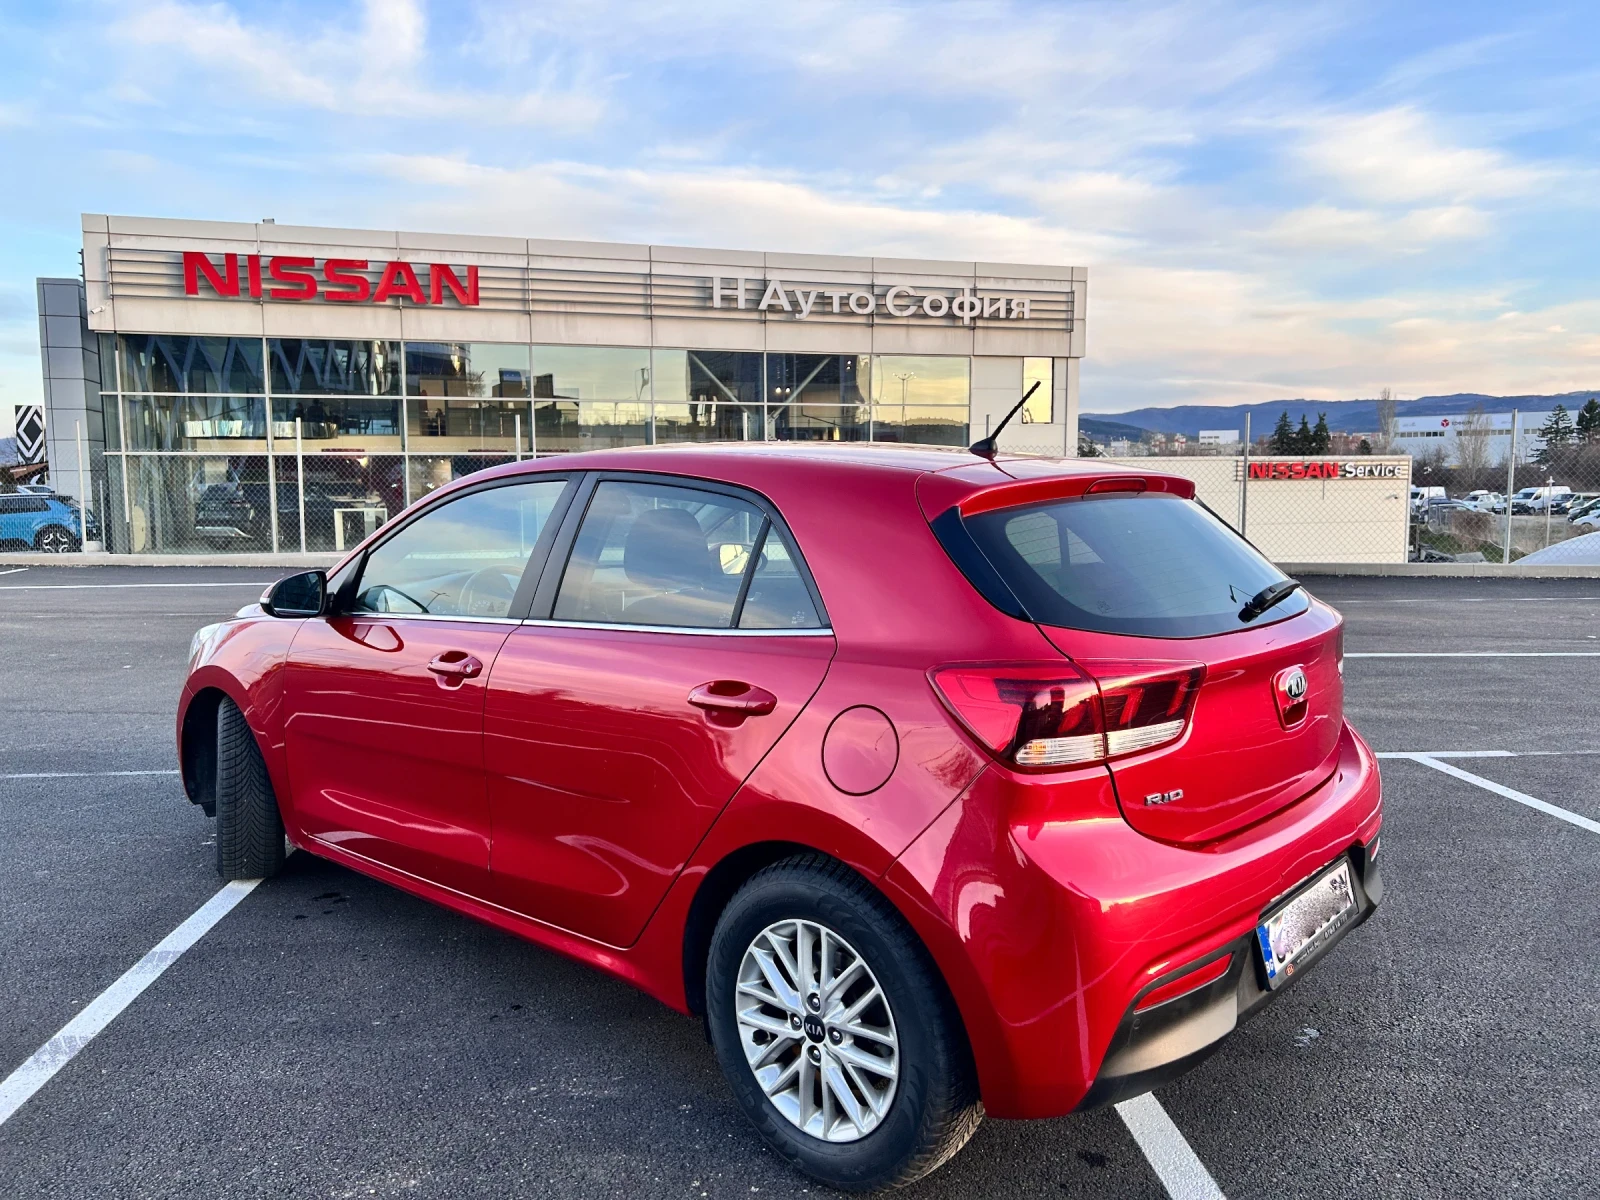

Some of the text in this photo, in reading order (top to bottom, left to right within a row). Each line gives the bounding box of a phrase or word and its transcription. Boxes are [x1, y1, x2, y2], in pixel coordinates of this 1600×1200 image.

[182, 251, 479, 306] NISSAN
[713, 276, 1031, 324] Н Ауто София
[1250, 462, 1402, 479] NISSAN Service
[1289, 674, 1306, 696] KIA
[805, 1022, 824, 1037] KIA
